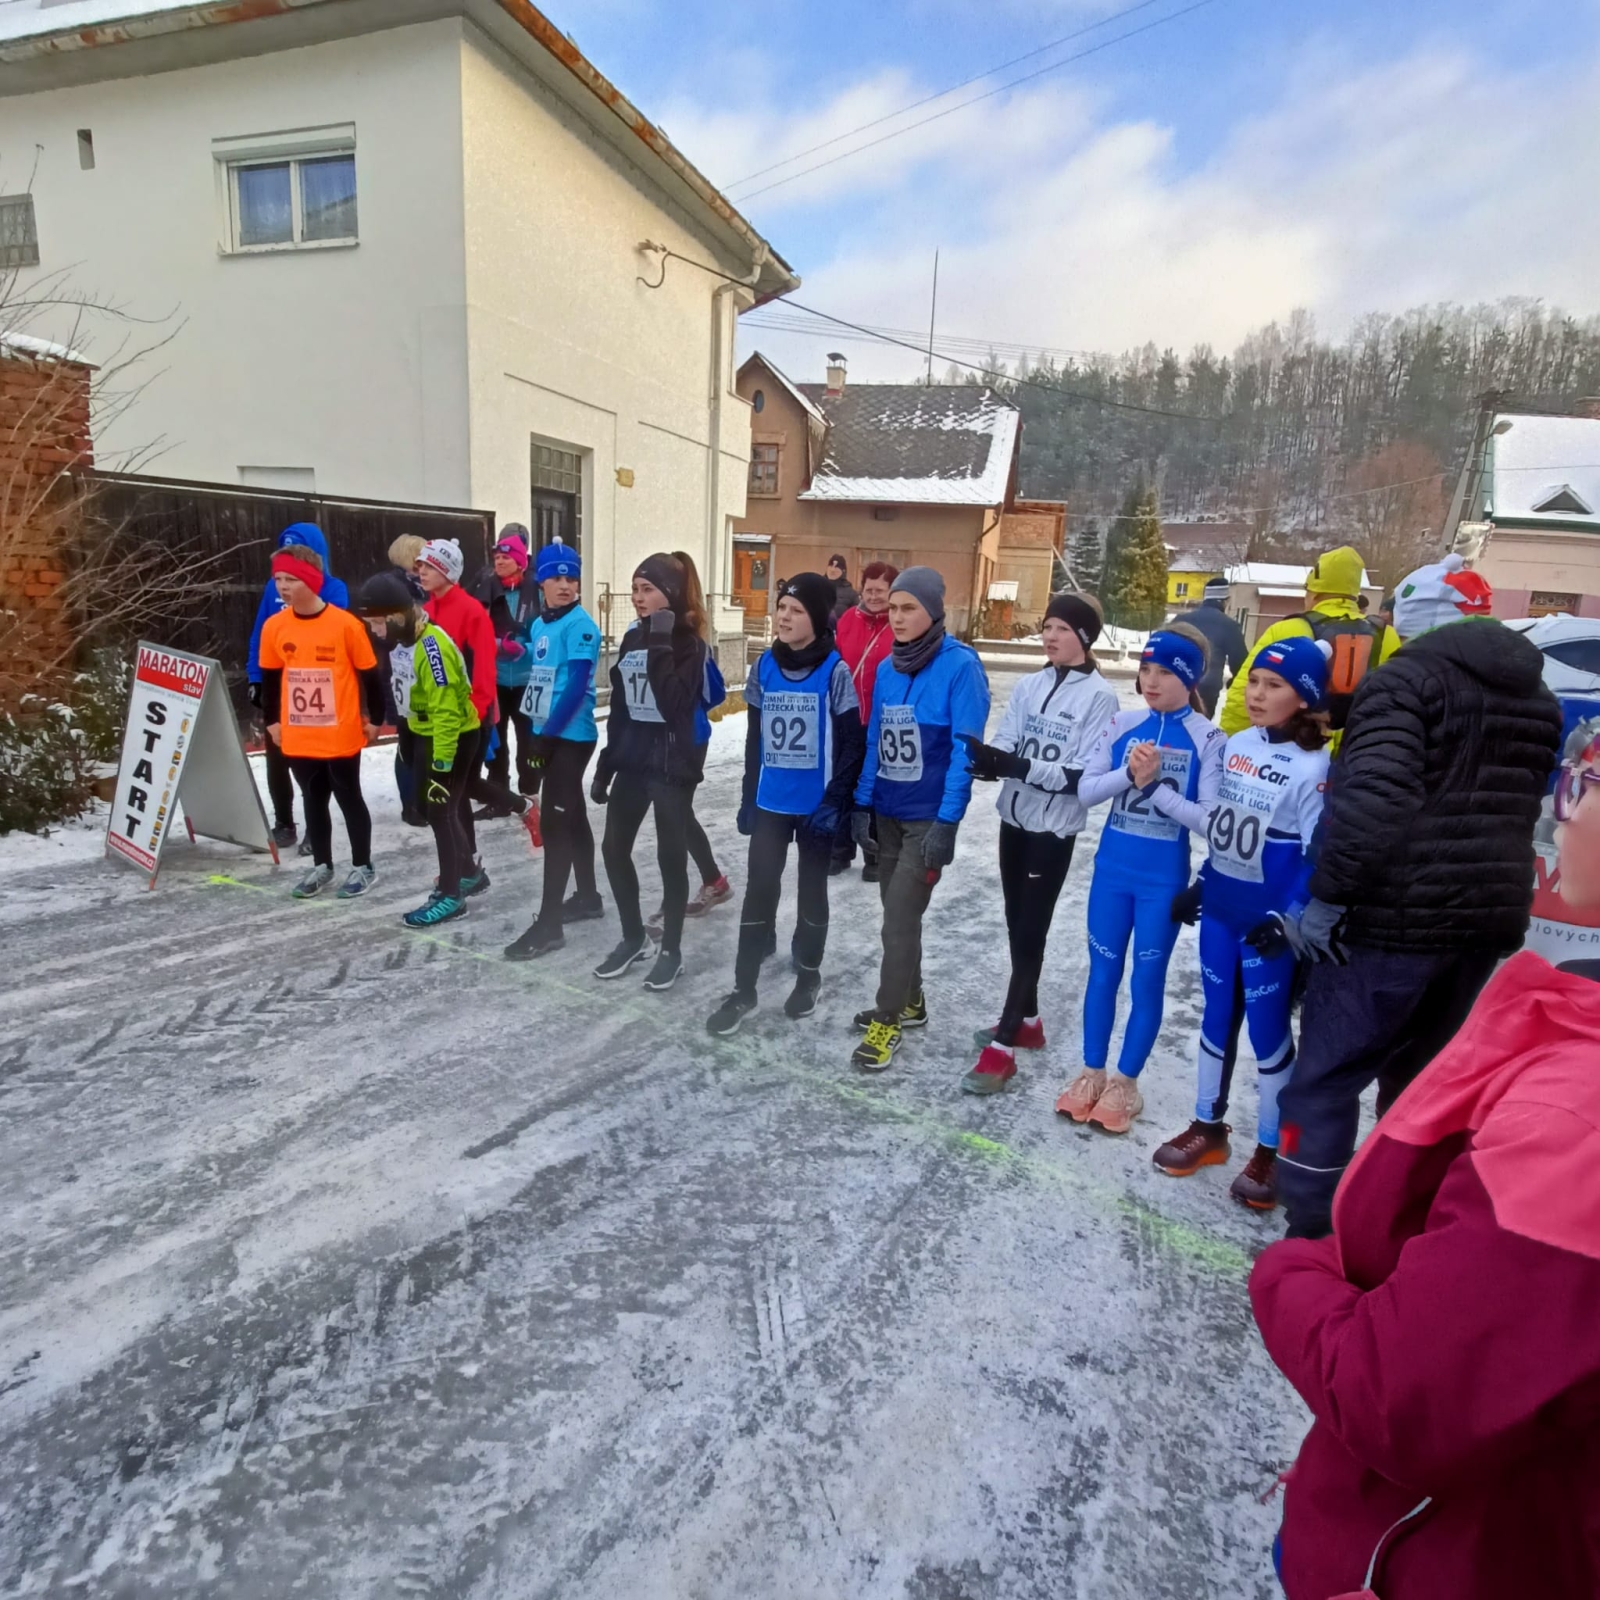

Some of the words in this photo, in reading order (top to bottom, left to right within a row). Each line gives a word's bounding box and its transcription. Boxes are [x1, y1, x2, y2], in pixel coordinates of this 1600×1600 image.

[139, 648, 209, 684] MARATON
[182, 683, 202, 695] stav
[292, 687, 326, 713] 64
[525, 685, 544, 714] 87
[797, 704, 816, 712] LIGA
[897, 717, 916, 725] LIGA
[770, 716, 807, 751] 92
[1047, 730, 1068, 742] LIGA
[126, 700, 168, 839] START
[1161, 762, 1187, 773] LIGA
[1248, 798, 1271, 813] LIGA
[1207, 804, 1260, 860] 190
[1529, 922, 1600, 944] lových
